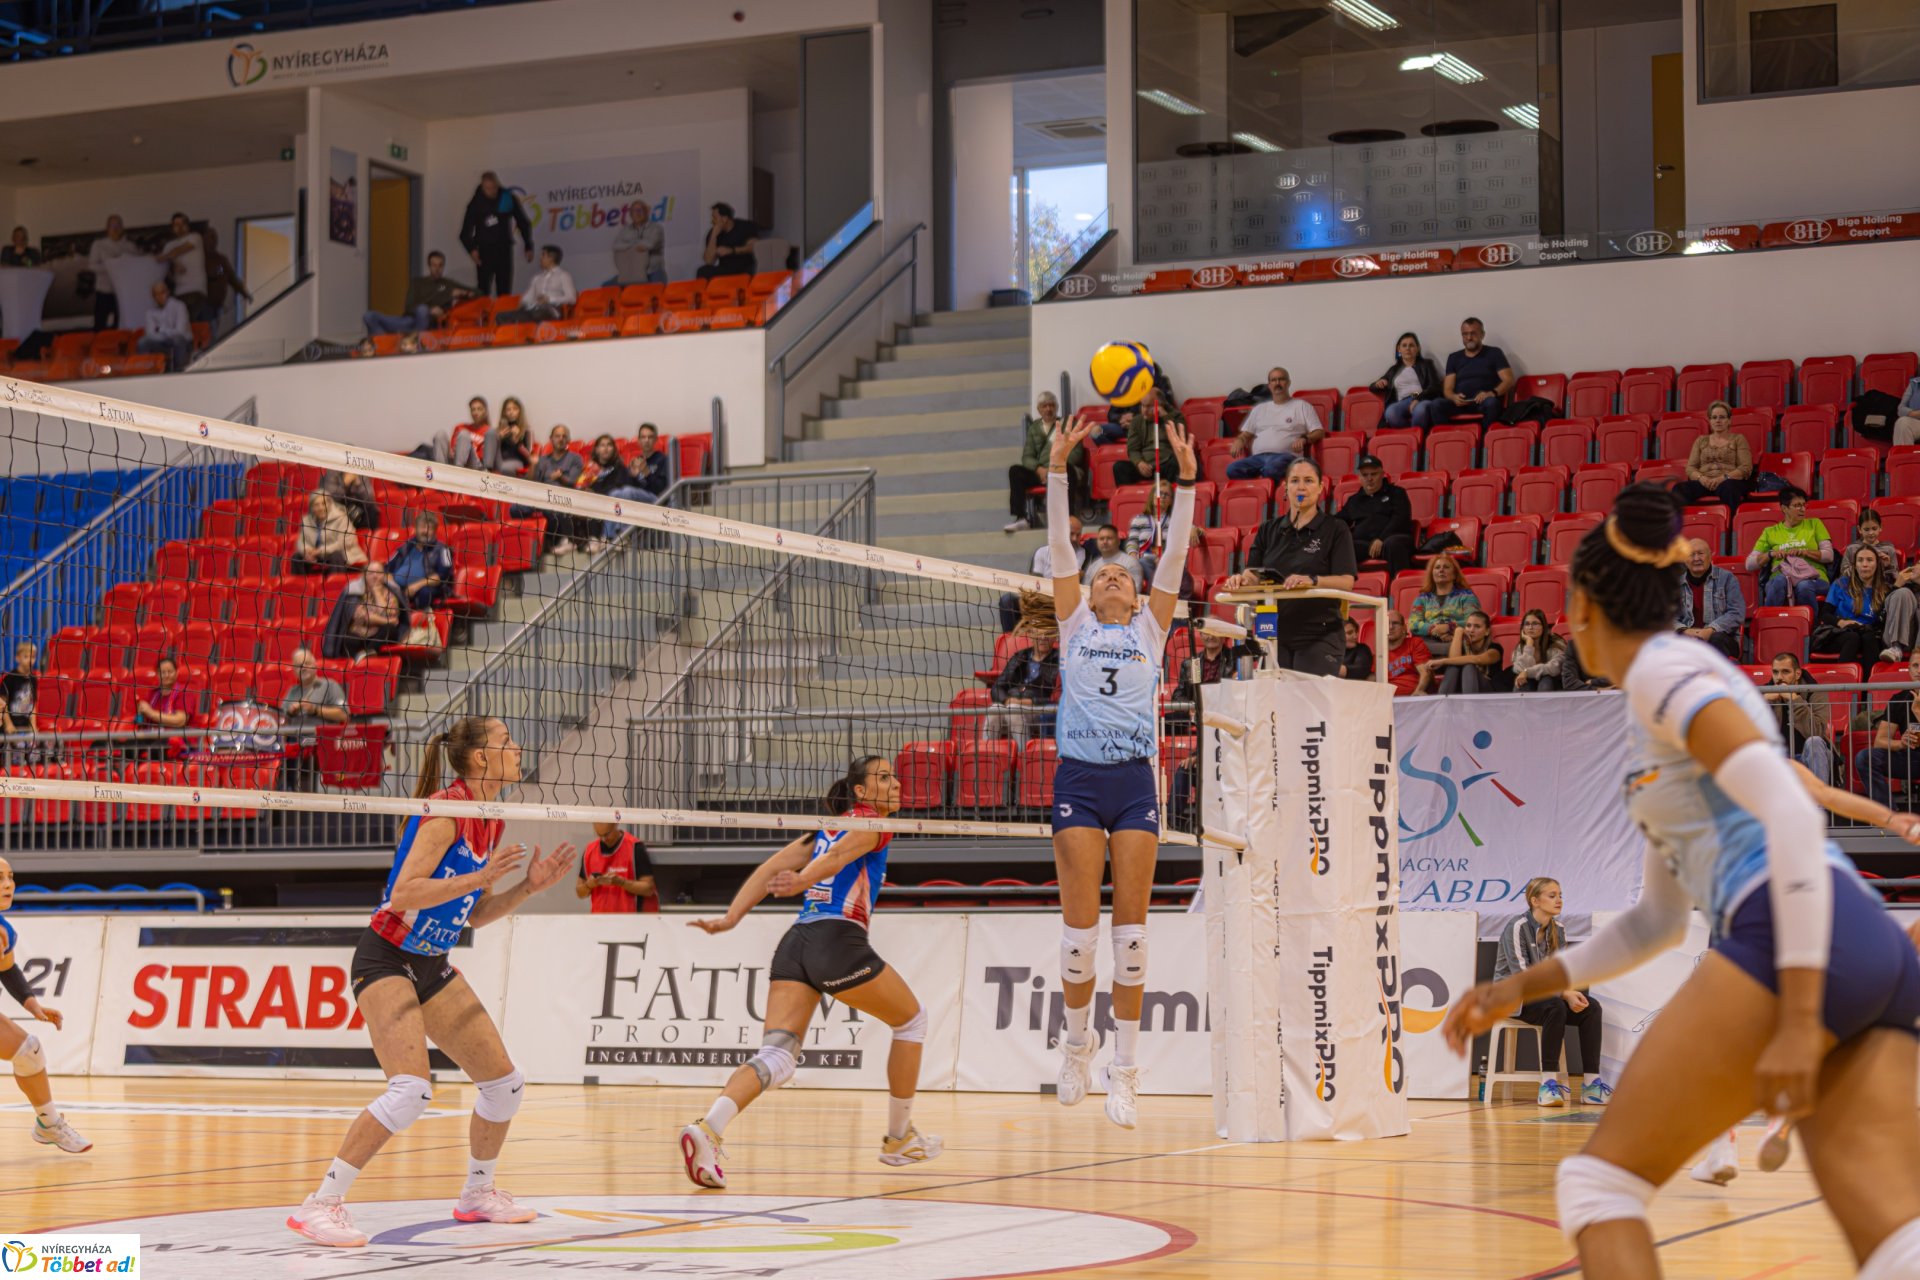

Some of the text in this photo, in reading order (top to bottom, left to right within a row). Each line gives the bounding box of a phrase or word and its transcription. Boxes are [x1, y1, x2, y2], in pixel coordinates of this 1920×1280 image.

[273, 43, 389, 70] NYÍREGYHÁZA
[549, 181, 643, 202] NYÍREGYHÁZA
[549, 204, 630, 232] Többet
[1865, 214, 1902, 225] Holding
[1702, 226, 1740, 237] Holding
[1793, 222, 1823, 240] BH
[1849, 227, 1890, 238] Csoport
[1552, 238, 1589, 249] Holding
[1636, 235, 1665, 252] BH
[1403, 249, 1439, 260] Holding
[1487, 247, 1514, 263] BH
[1539, 250, 1577, 261] Csoport
[1260, 260, 1295, 270] Holding
[1391, 261, 1428, 272] Csoport
[1200, 269, 1228, 284] BH
[1248, 272, 1284, 282] Csoport
[99, 401, 136, 423] FATUM
[345, 450, 376, 470] FATUM
[1099, 667, 1120, 697] 3
[94, 785, 123, 800] FATUM
[1300, 721, 1331, 876] TippmixPRO
[343, 798, 368, 811] FATUM
[452, 895, 475, 926] 3
[1308, 946, 1336, 1102] TippmixPRO
[591, 1024, 863, 1045] PROPETY
[820, 1054, 858, 1066] KFT
